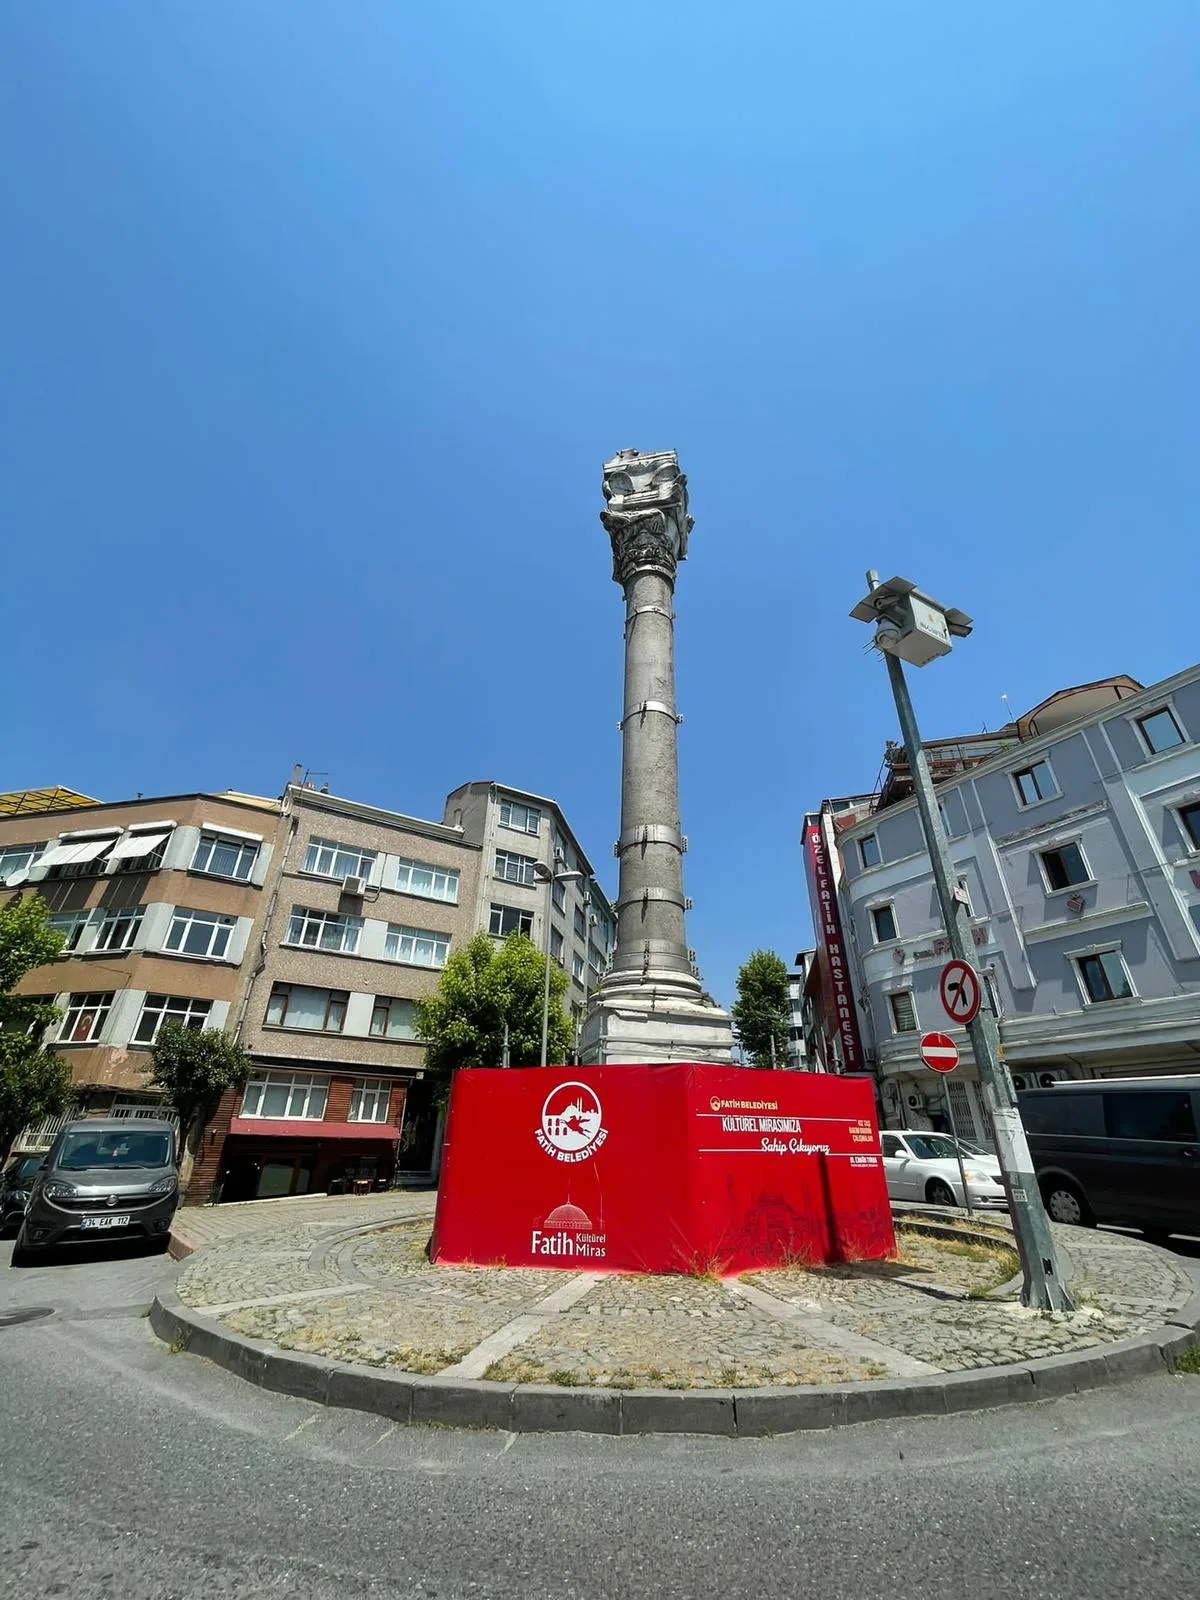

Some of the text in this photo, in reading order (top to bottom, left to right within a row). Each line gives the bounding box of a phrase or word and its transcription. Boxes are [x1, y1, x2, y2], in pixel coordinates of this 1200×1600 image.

[811, 832, 855, 1062] ÖZEL FATİH HASTANESİ
[720, 1098, 778, 1110] FATİH BELEDİYESİ
[722, 1115, 759, 1132] KÜLTÜREL
[534, 1128, 557, 1157] FATİH
[761, 1137, 830, 1155] Sahip Çıkıyoruz
[87, 1218, 96, 1227] 34
[531, 1230, 606, 1255] Fatih Kültürel
[575, 1243, 606, 1257] Miras
